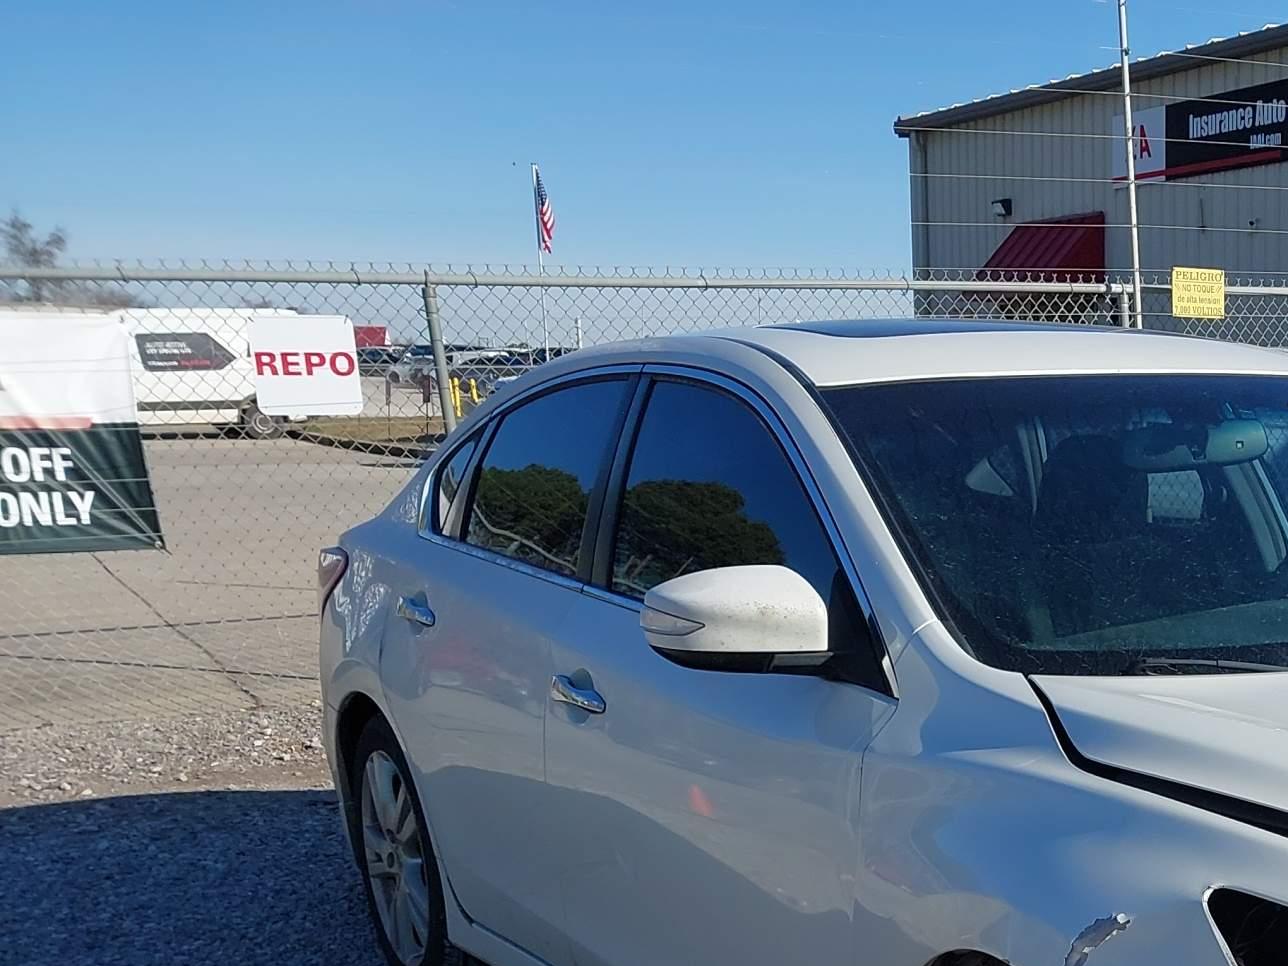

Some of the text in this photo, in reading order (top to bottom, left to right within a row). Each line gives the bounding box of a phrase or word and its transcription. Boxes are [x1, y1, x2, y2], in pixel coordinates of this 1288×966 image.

[1188, 105, 1253, 140] Insurance
[1254, 100, 1287, 127] Auto
[1175, 270, 1222, 282] PELIGRO
[1182, 283, 1215, 294] NO TOQUE
[254, 351, 355, 377] REPO
[1, 446, 74, 483] OFF
[0, 490, 95, 527] ONLY
